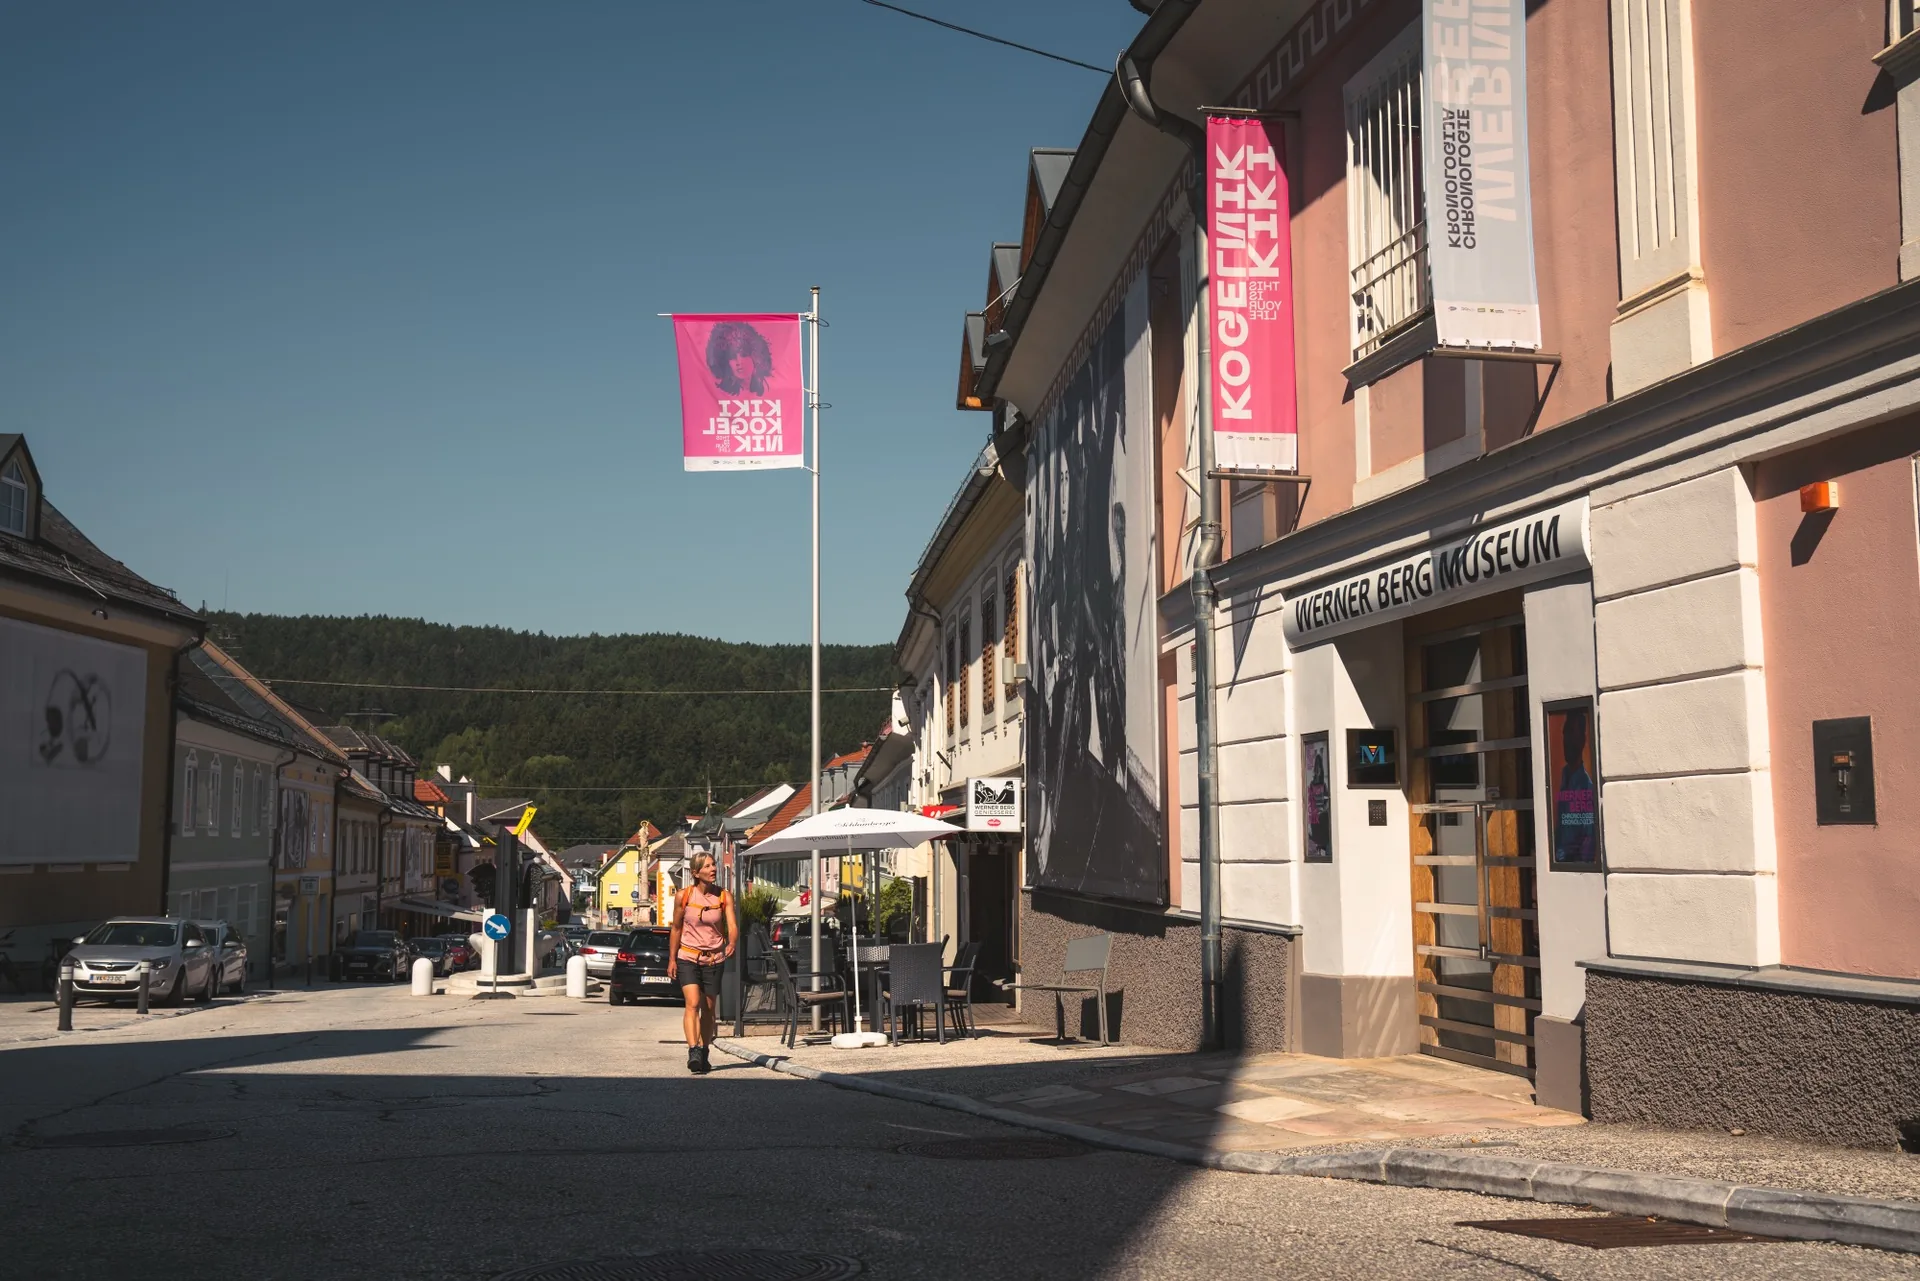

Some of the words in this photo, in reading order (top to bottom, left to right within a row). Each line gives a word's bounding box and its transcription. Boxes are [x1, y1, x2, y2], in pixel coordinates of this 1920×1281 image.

[1295, 577, 1373, 633] WERNER
[1376, 557, 1433, 611] BERG
[1438, 514, 1562, 591] MUSEUM
